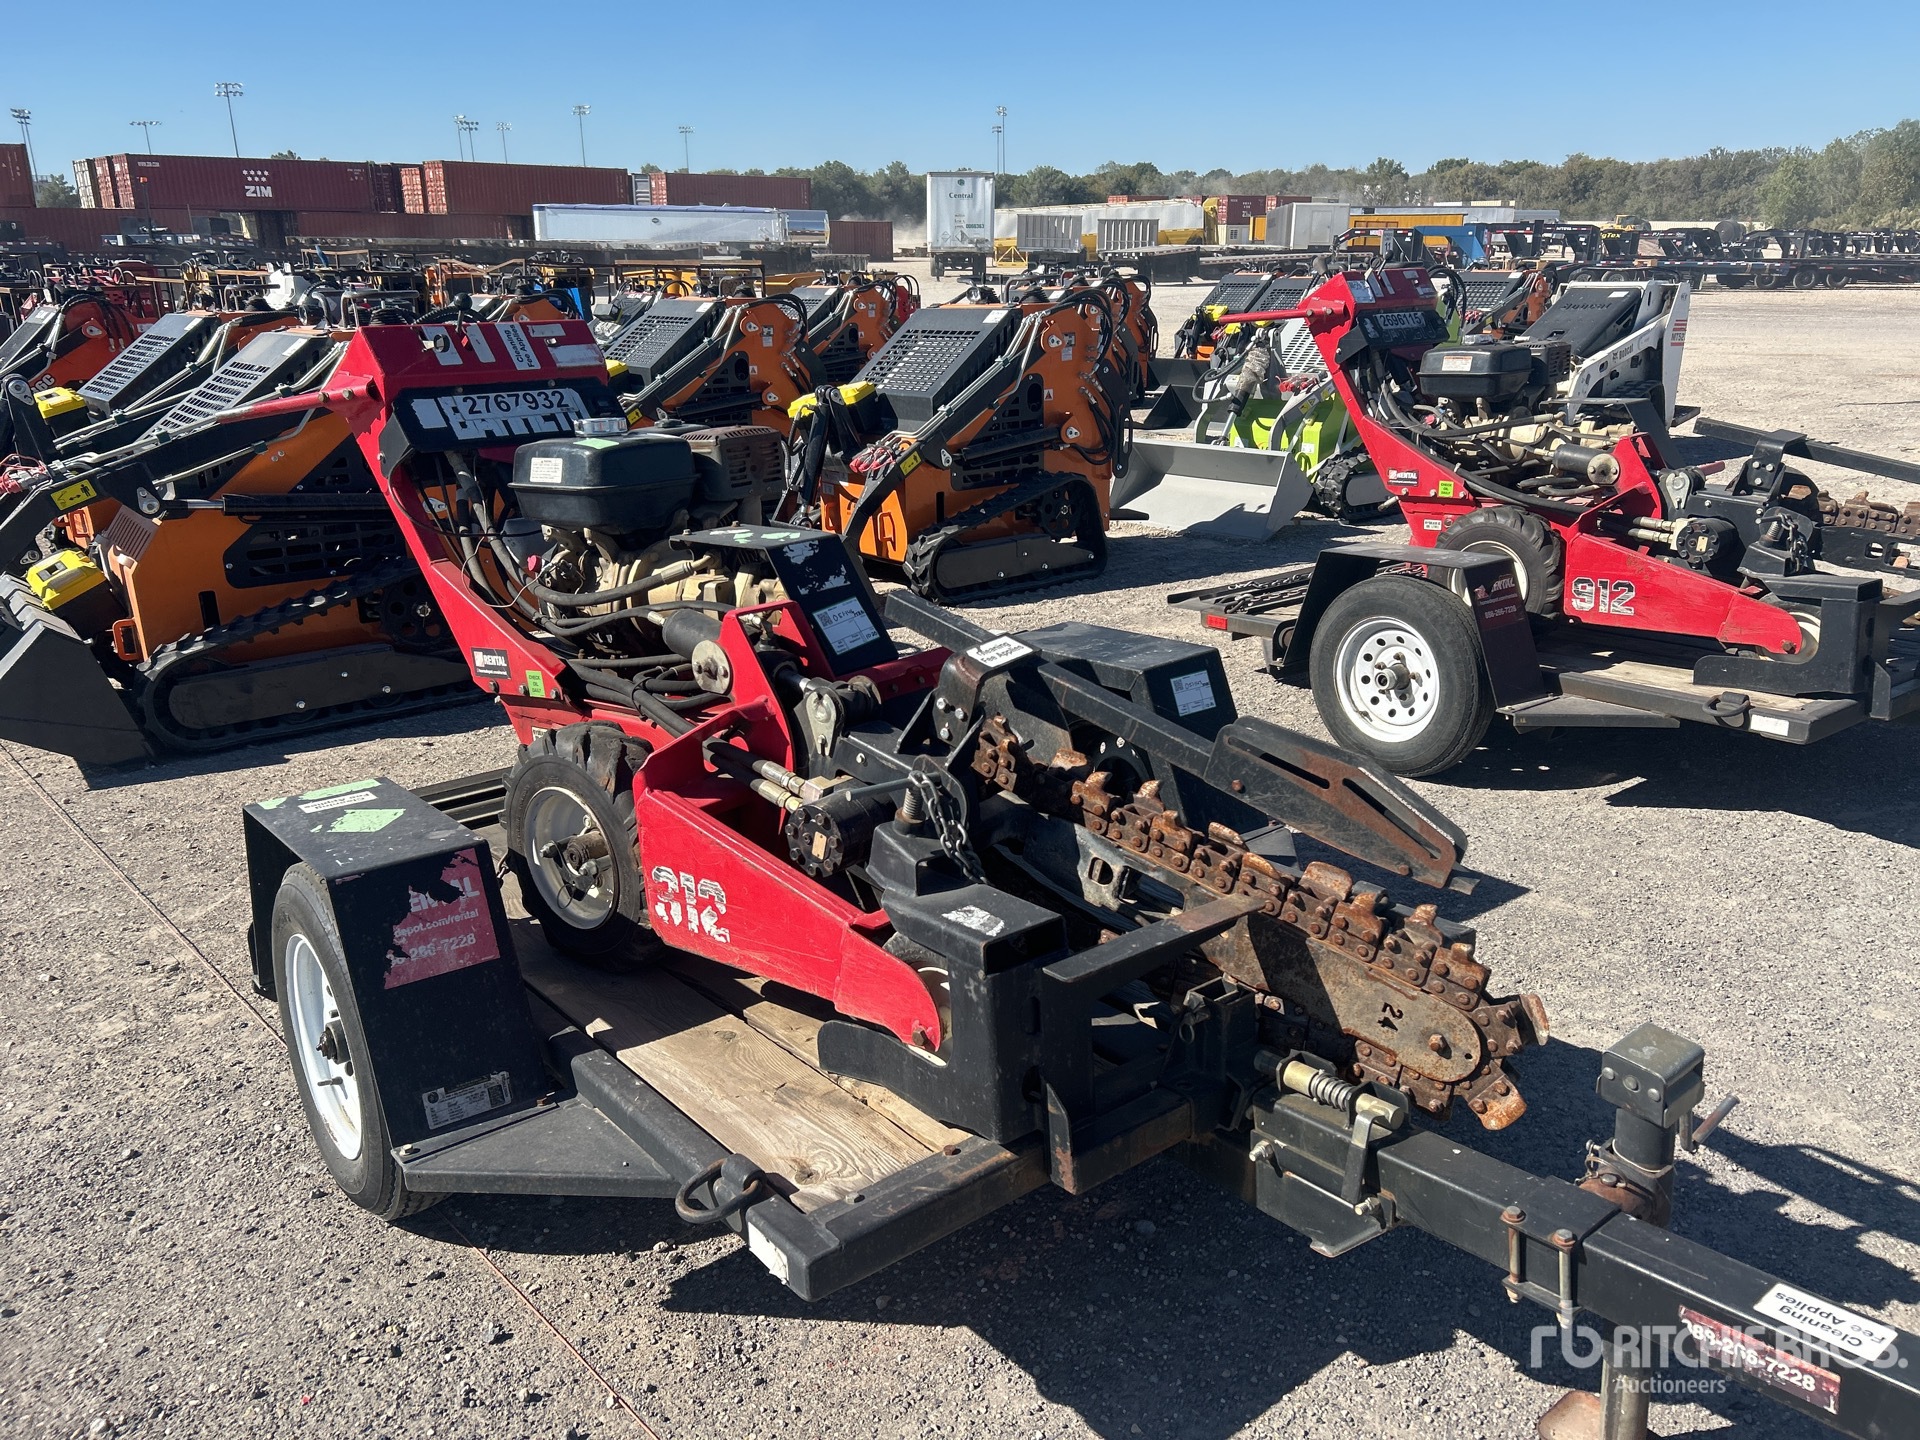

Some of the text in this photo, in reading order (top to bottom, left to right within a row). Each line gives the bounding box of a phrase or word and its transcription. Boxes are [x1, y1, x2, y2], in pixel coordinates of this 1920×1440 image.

[244, 185, 273, 198] ZIM
[1380, 312, 1422, 327] 2696115
[504, 329, 524, 363] Cleaning
[509, 324, 536, 368] Fee Applies
[462, 390, 570, 416] 2767932
[1571, 576, 1636, 616] 912
[483, 654, 508, 667] RENTAL
[1775, 1291, 1887, 1345] Fee Applies
[1778, 1305, 1863, 1348] Cleaning
